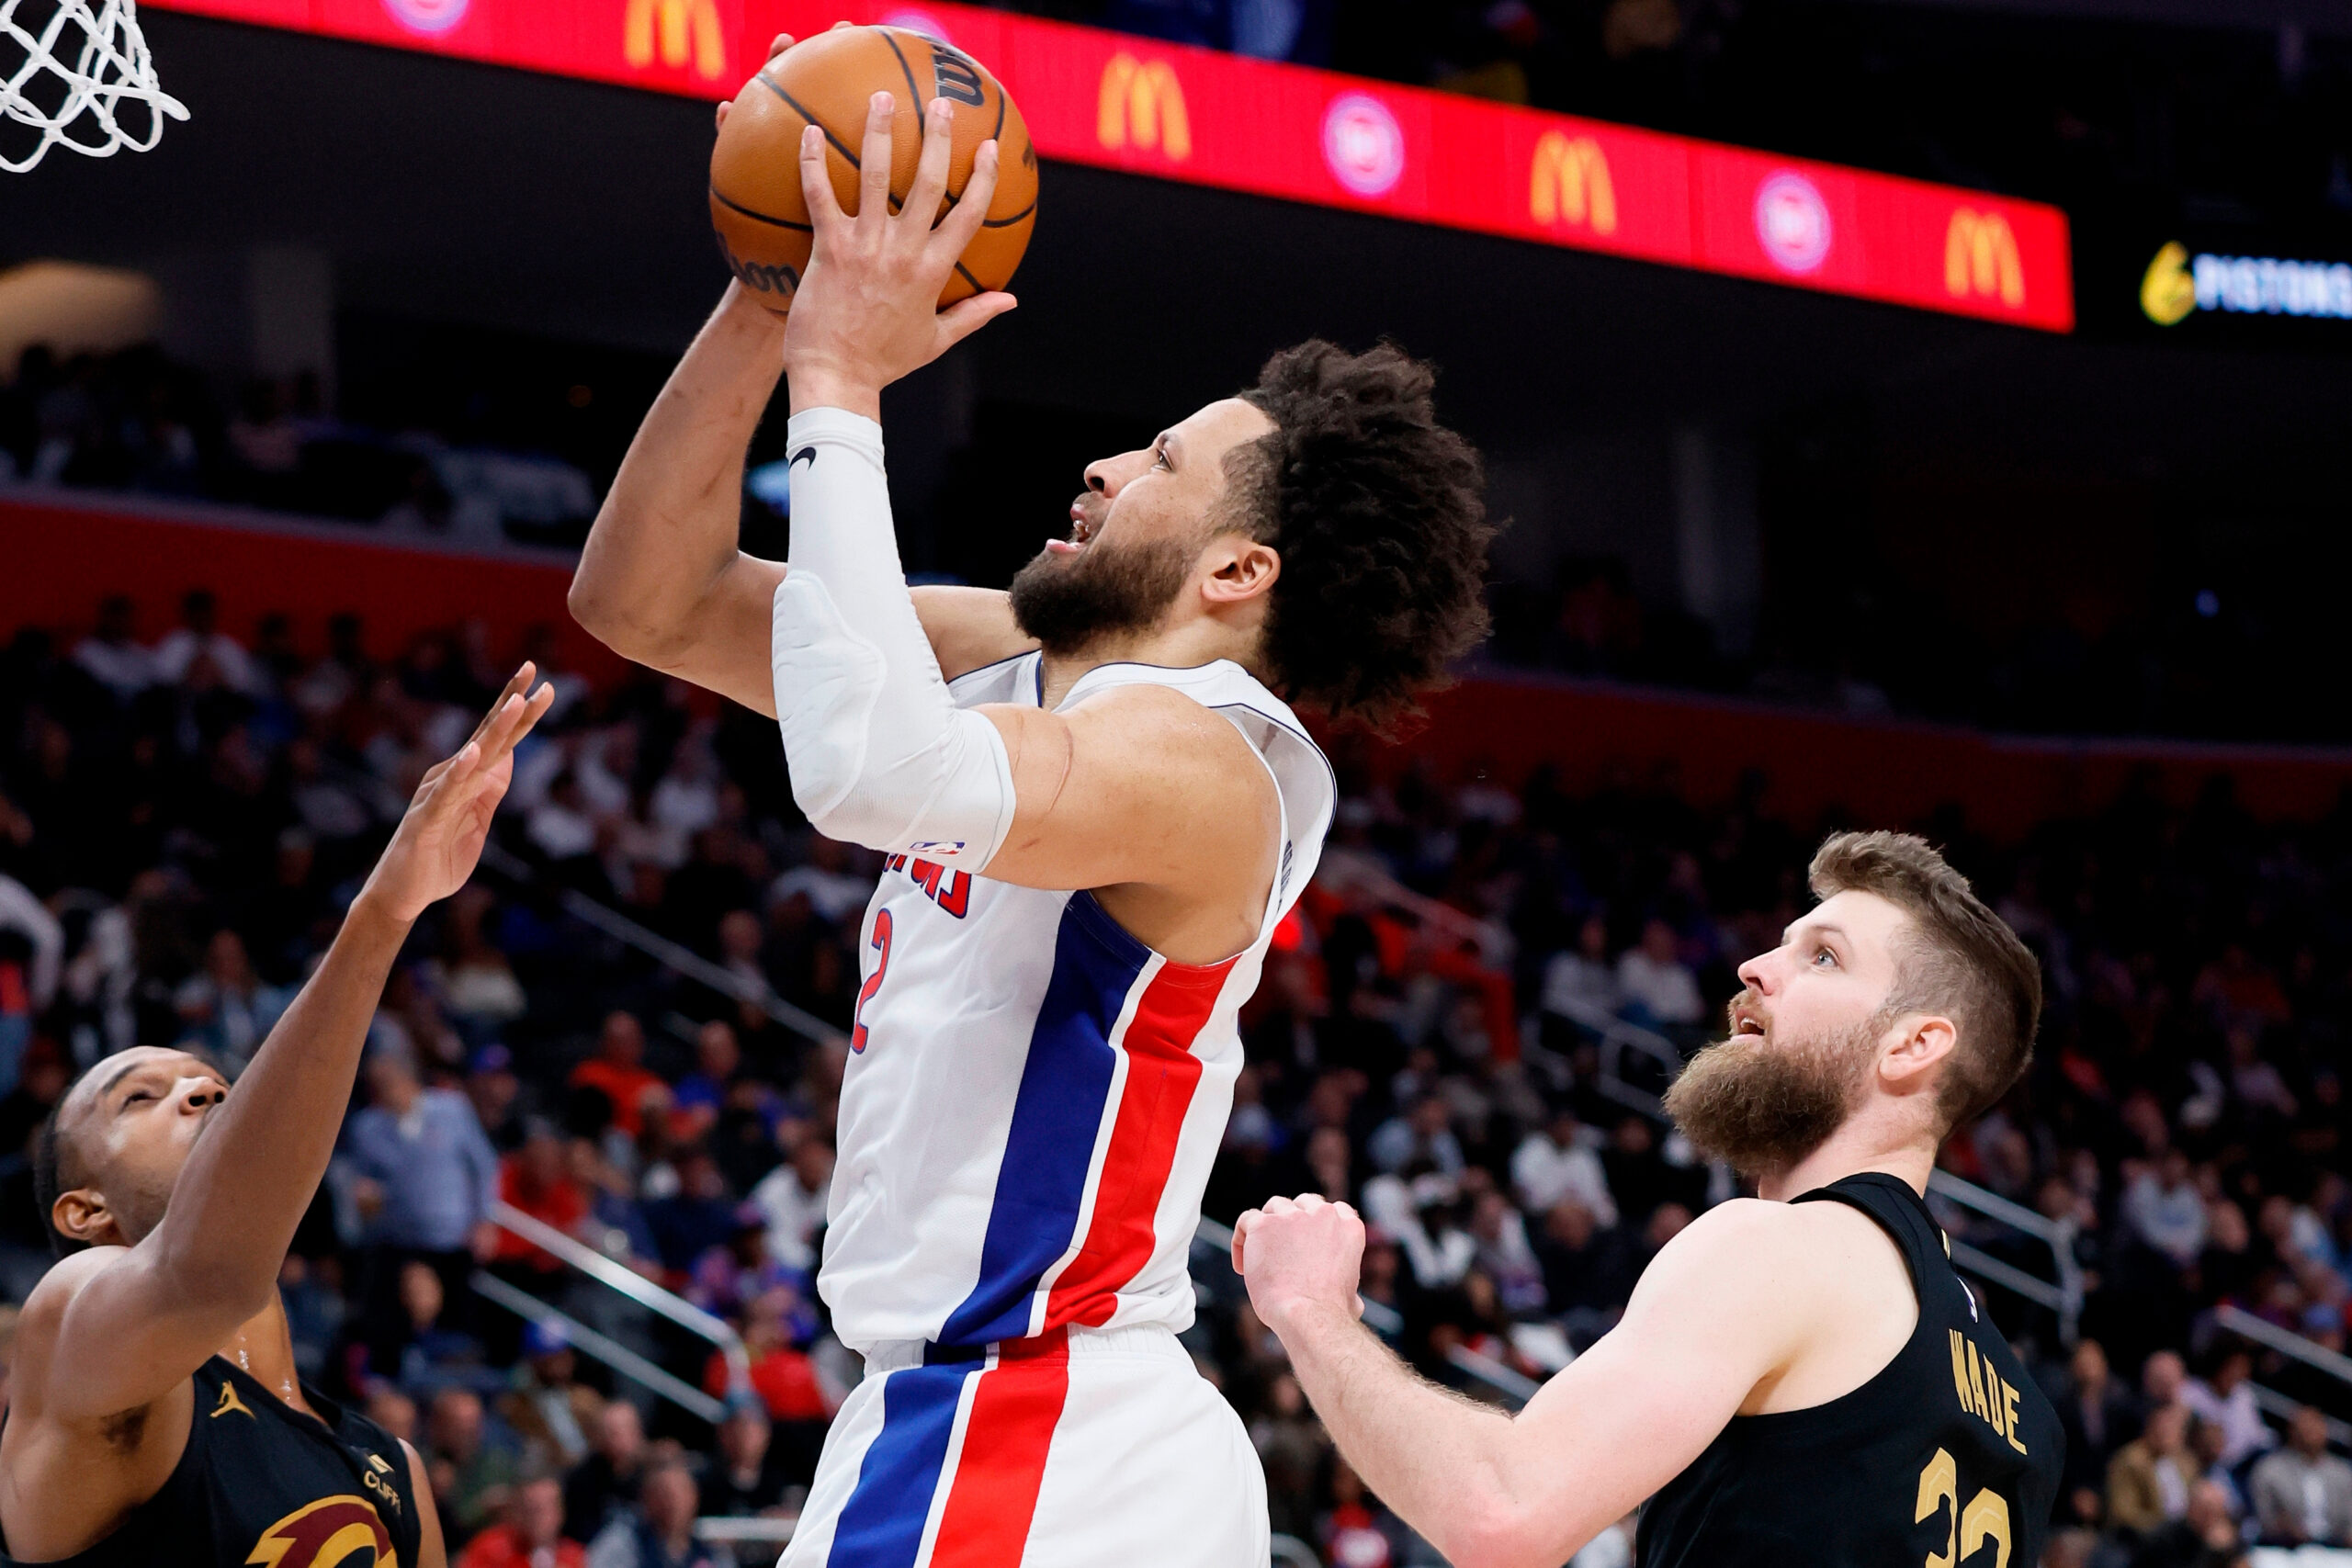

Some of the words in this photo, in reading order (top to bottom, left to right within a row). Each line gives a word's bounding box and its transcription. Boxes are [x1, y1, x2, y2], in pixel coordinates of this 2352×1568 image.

[2193, 254, 2352, 319] PISTONS
[852, 908, 893, 1055] 2
[1949, 1328, 2028, 1455] WADE
[364, 1470, 401, 1515] CLIFF
